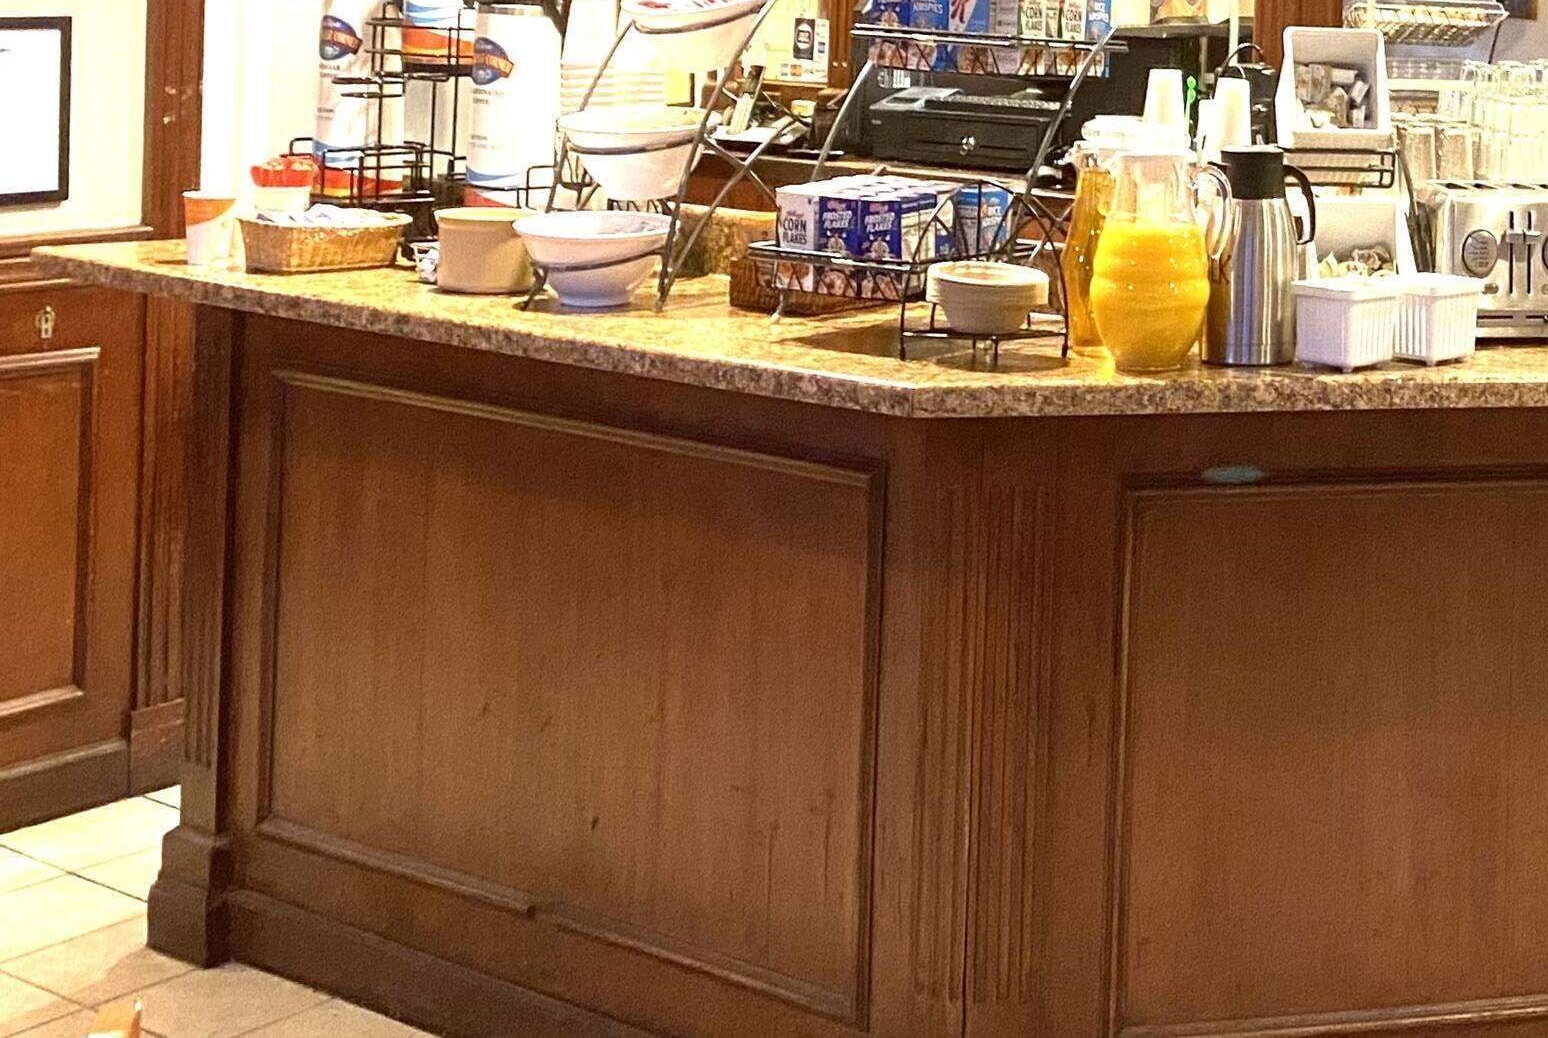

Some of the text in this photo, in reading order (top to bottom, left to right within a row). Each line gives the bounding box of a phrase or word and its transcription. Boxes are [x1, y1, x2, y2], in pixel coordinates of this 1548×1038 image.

[1025, 6, 1043, 19] CORN
[1065, 9, 1083, 22] CORN
[783, 217, 807, 232] CORN
[783, 231, 807, 245] FLAKES
